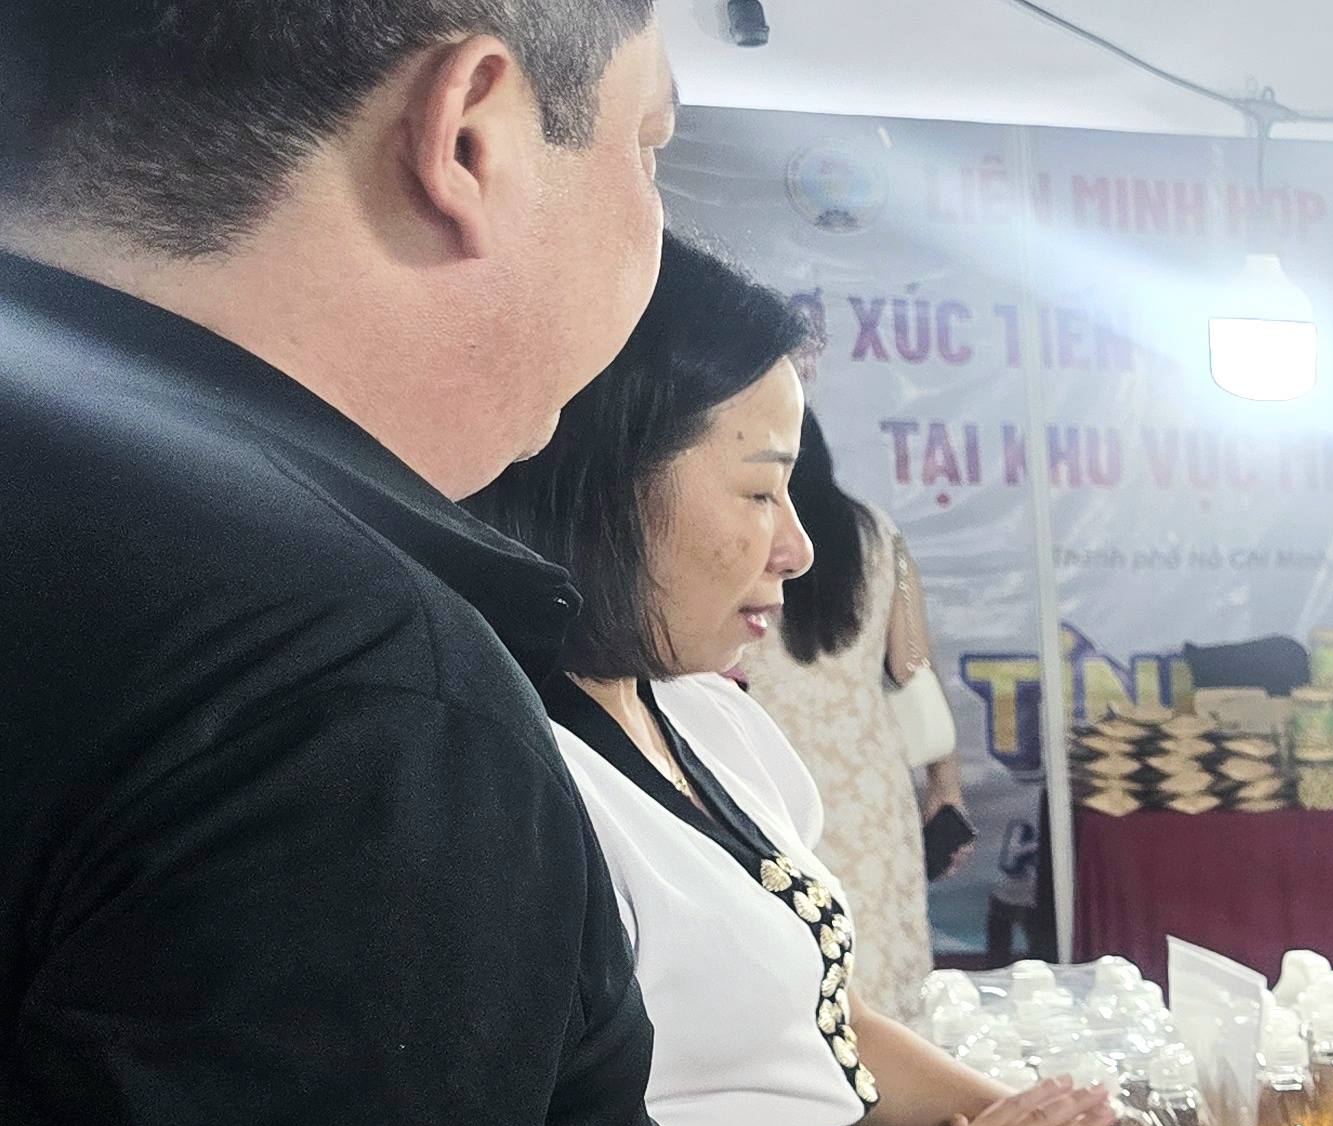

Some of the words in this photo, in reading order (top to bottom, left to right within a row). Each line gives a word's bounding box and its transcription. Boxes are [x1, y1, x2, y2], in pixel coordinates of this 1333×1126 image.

[1071, 174, 1205, 235] MINH
[848, 282, 974, 366] XÚC
[879, 420, 983, 508] TẠI
[1002, 424, 1123, 491] KHU
